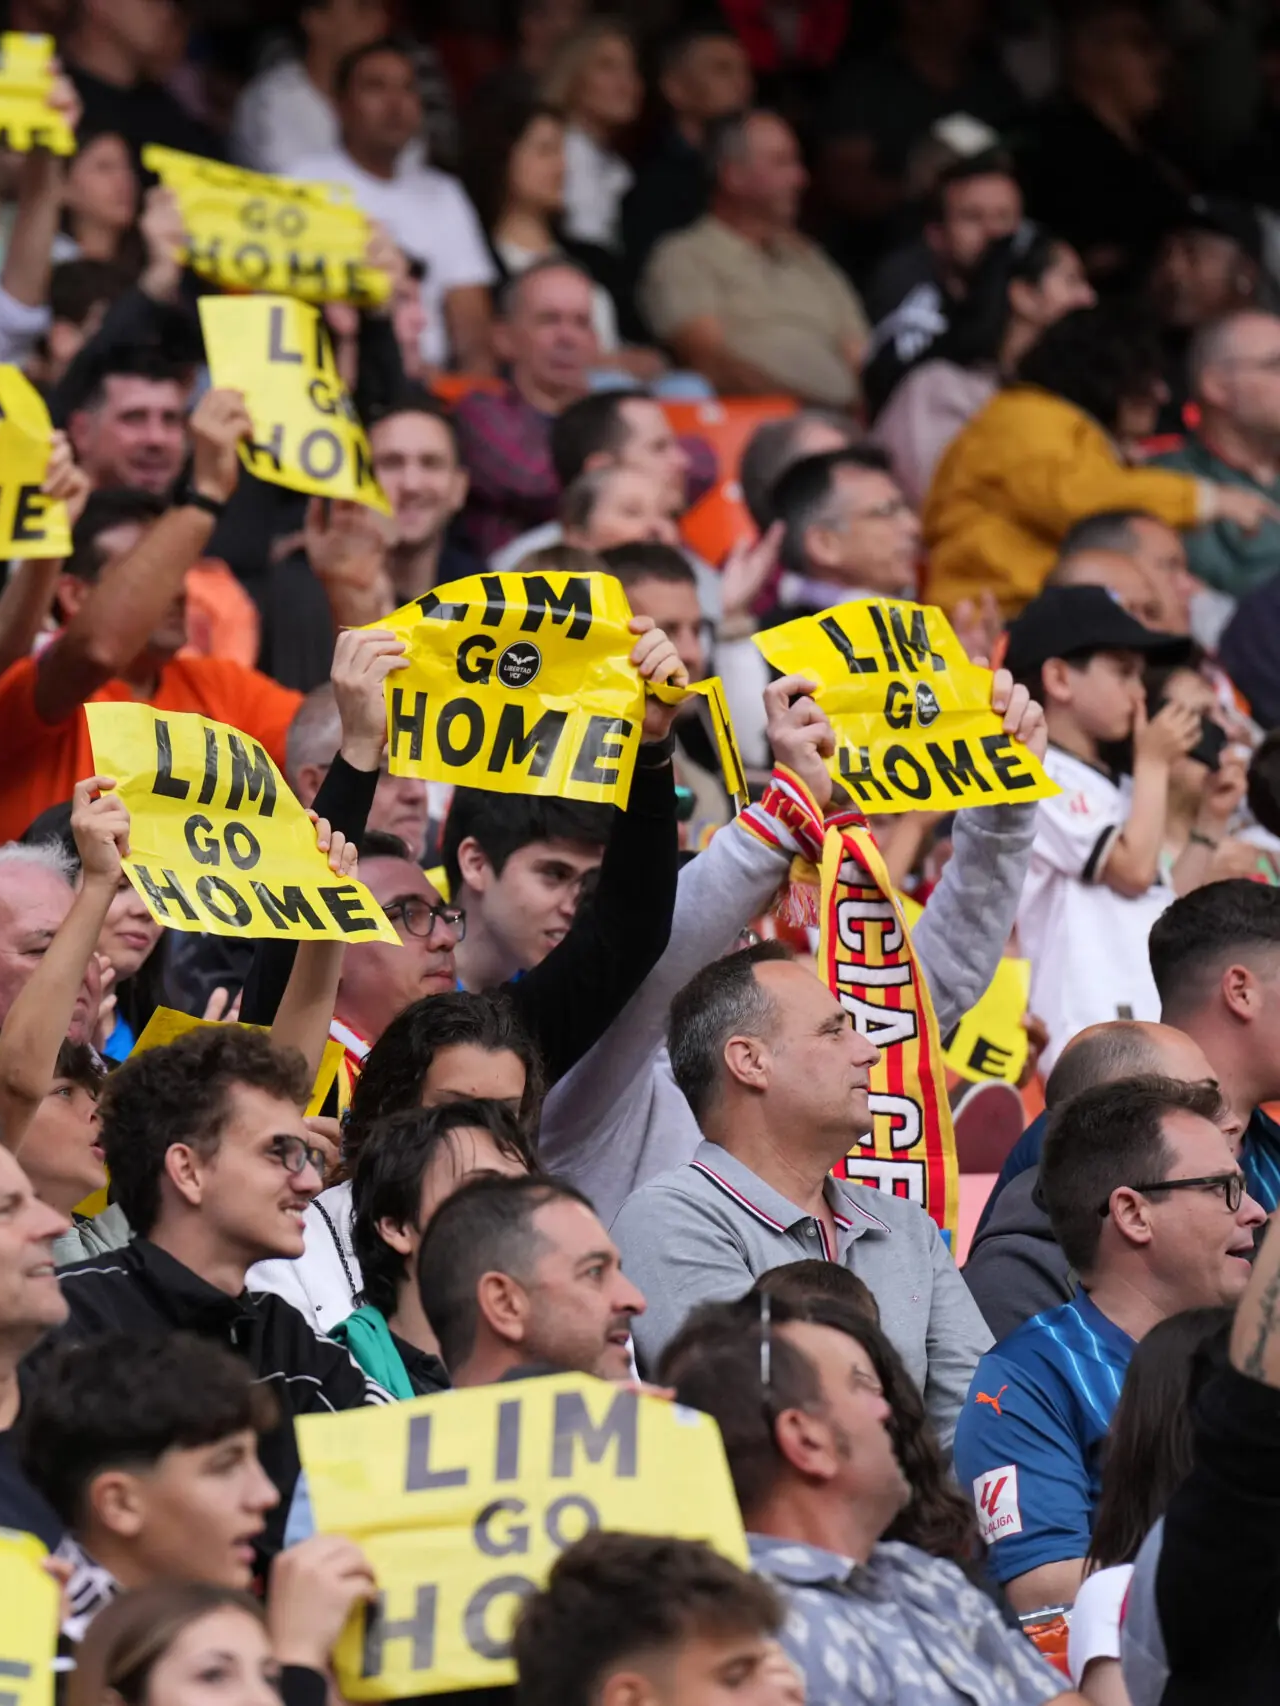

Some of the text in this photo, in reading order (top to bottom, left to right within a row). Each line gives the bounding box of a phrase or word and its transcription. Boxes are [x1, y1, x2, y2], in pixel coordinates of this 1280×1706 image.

[238, 200, 307, 241] GO
[269, 306, 327, 370] LI
[247, 423, 372, 489] HO
[415, 575, 594, 641] LIM
[817, 604, 948, 675] LIM
[503, 664, 532, 675] LIBERTAD
[151, 717, 278, 818] LIM
[390, 687, 634, 785] HOME
[838, 733, 1036, 802] HOME
[184, 813, 262, 871] GO
[132, 863, 379, 934] HOME
[404, 1390, 639, 1493] LIM
[472, 1494, 601, 1558] GO
[984, 1513, 1015, 1536] LALIGA
[359, 1573, 542, 1680] HO
